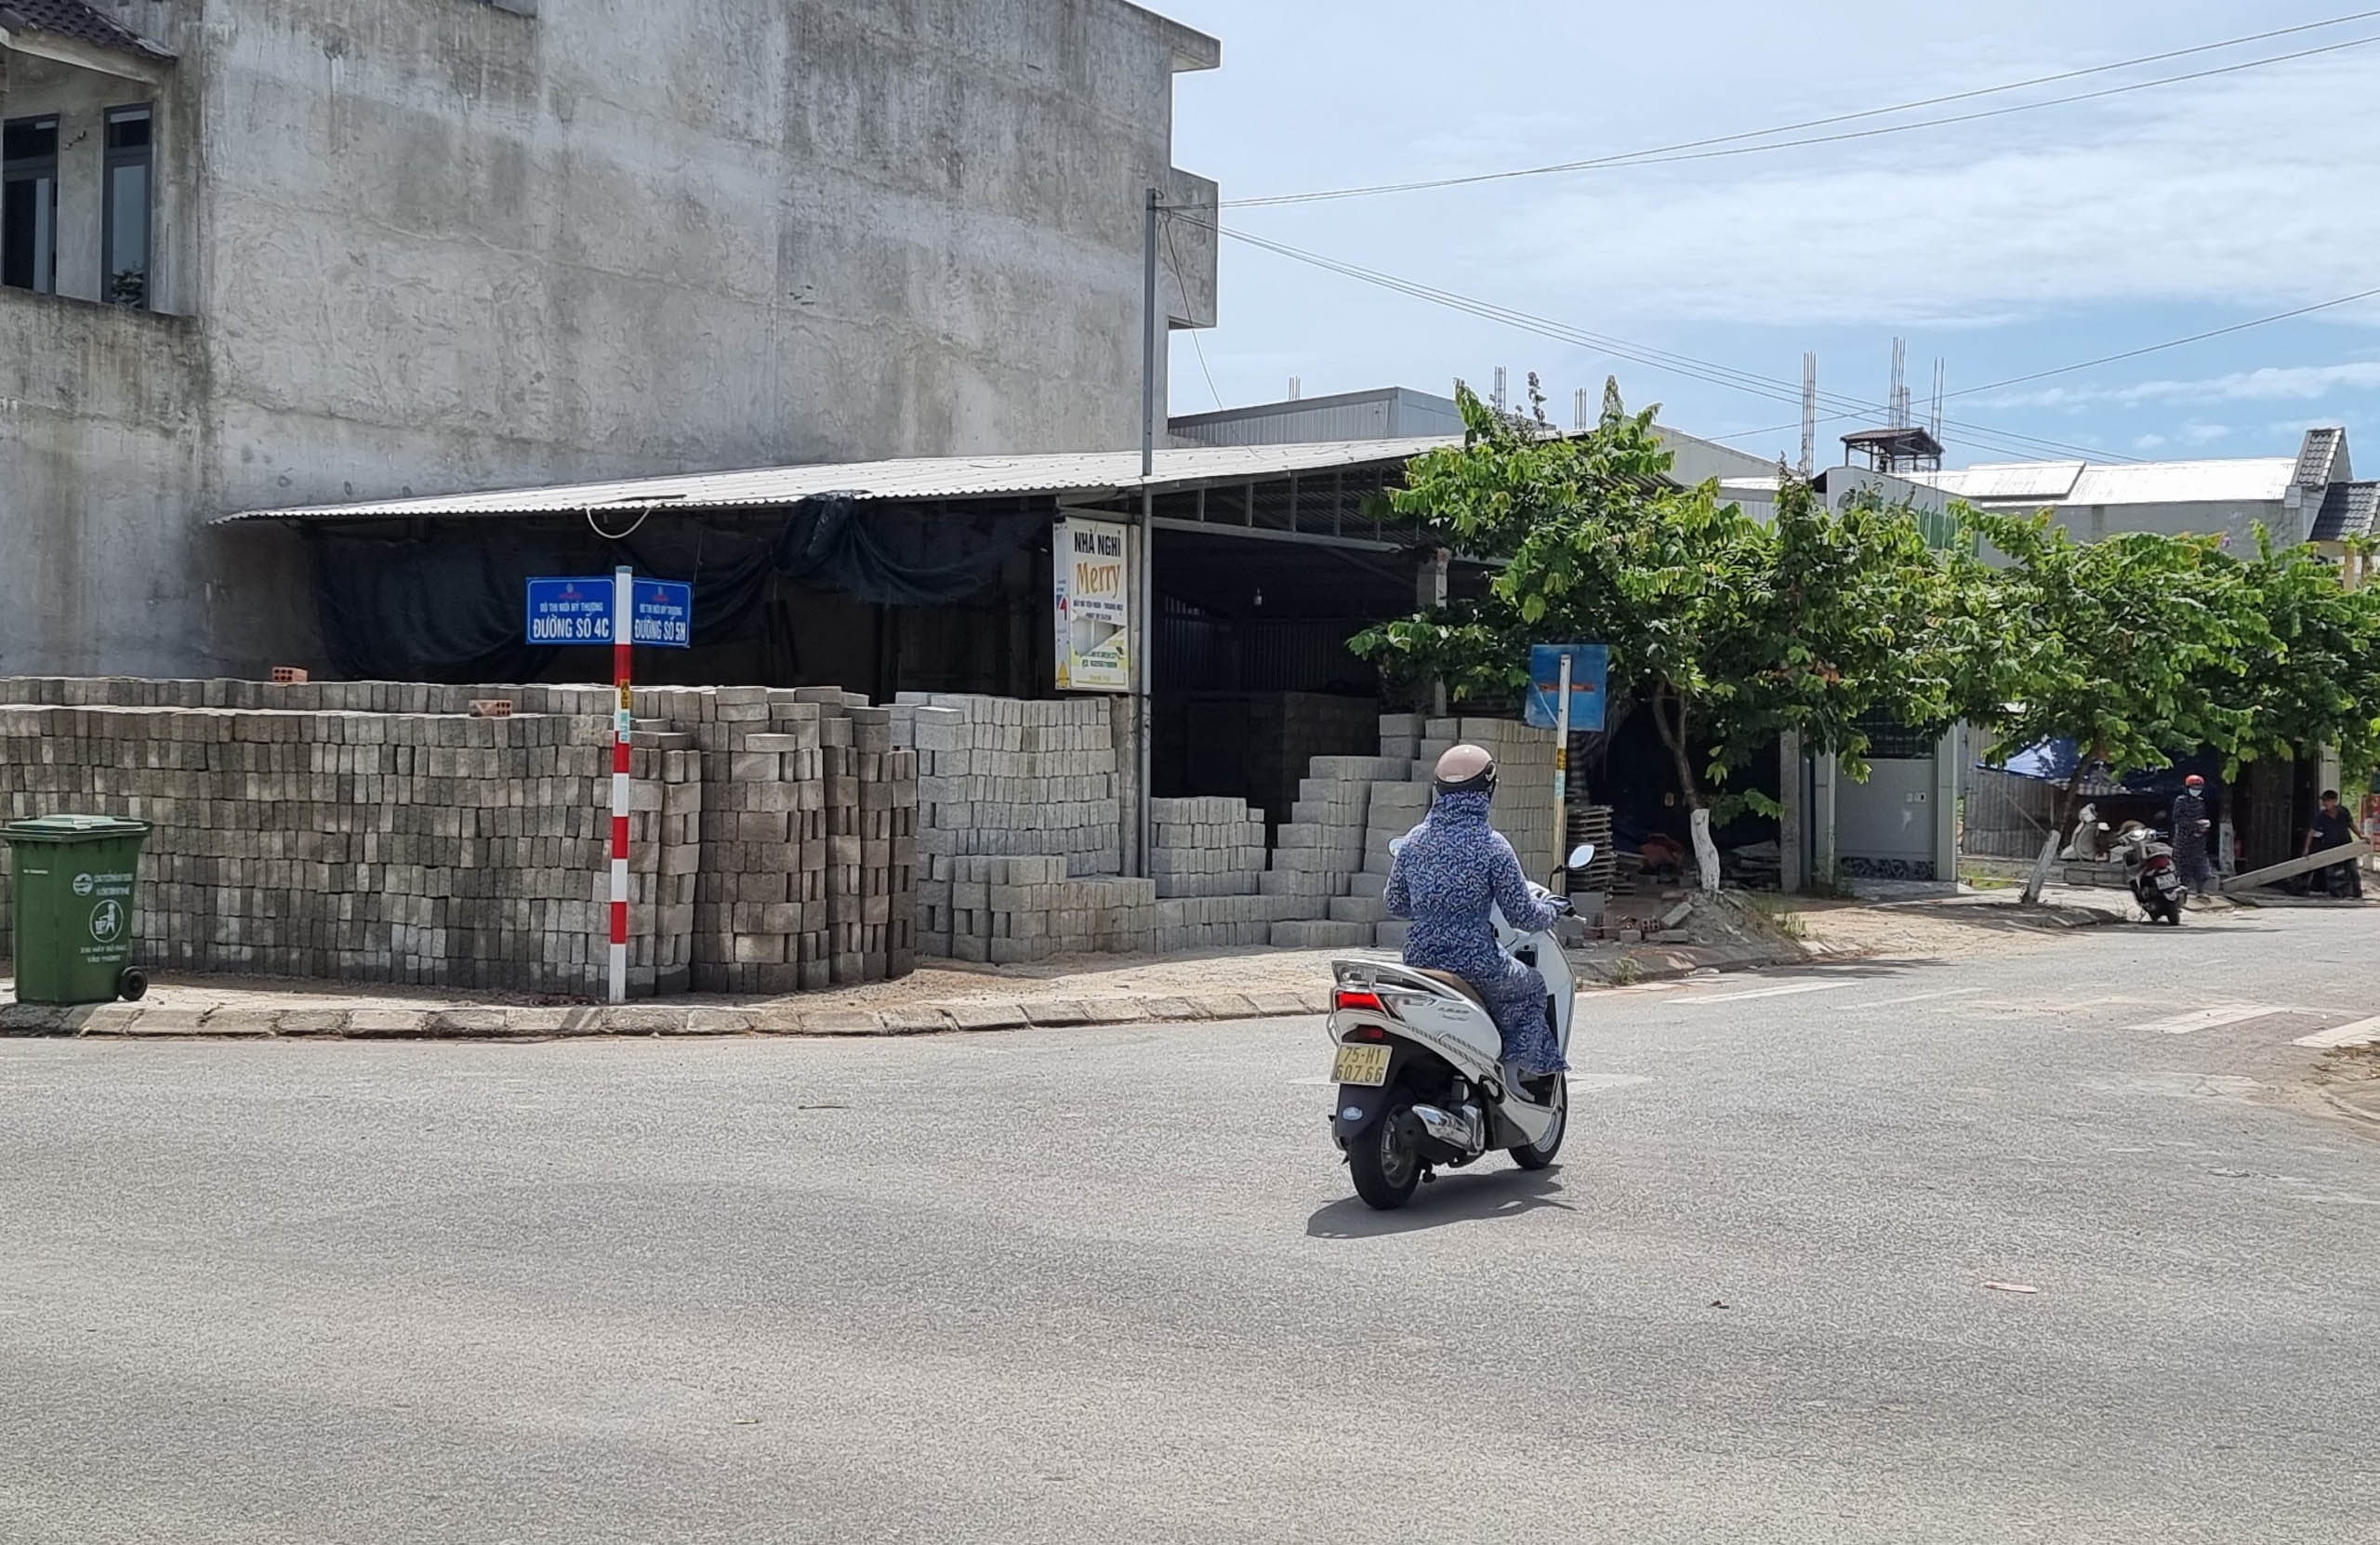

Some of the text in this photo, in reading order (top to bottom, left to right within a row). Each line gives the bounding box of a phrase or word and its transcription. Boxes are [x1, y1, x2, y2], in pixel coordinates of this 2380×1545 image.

[1074, 528, 1121, 558] NHÀ NGHỈ
[1076, 561, 1121, 600] Merry
[533, 612, 610, 639] ĐƯỜNG SỐ 4C
[634, 614, 662, 640] ĐƯỜNG
[663, 615, 675, 640] SỐ
[1344, 1046, 1382, 1064] 75-H1
[1335, 1064, 1384, 1083] 607.66
